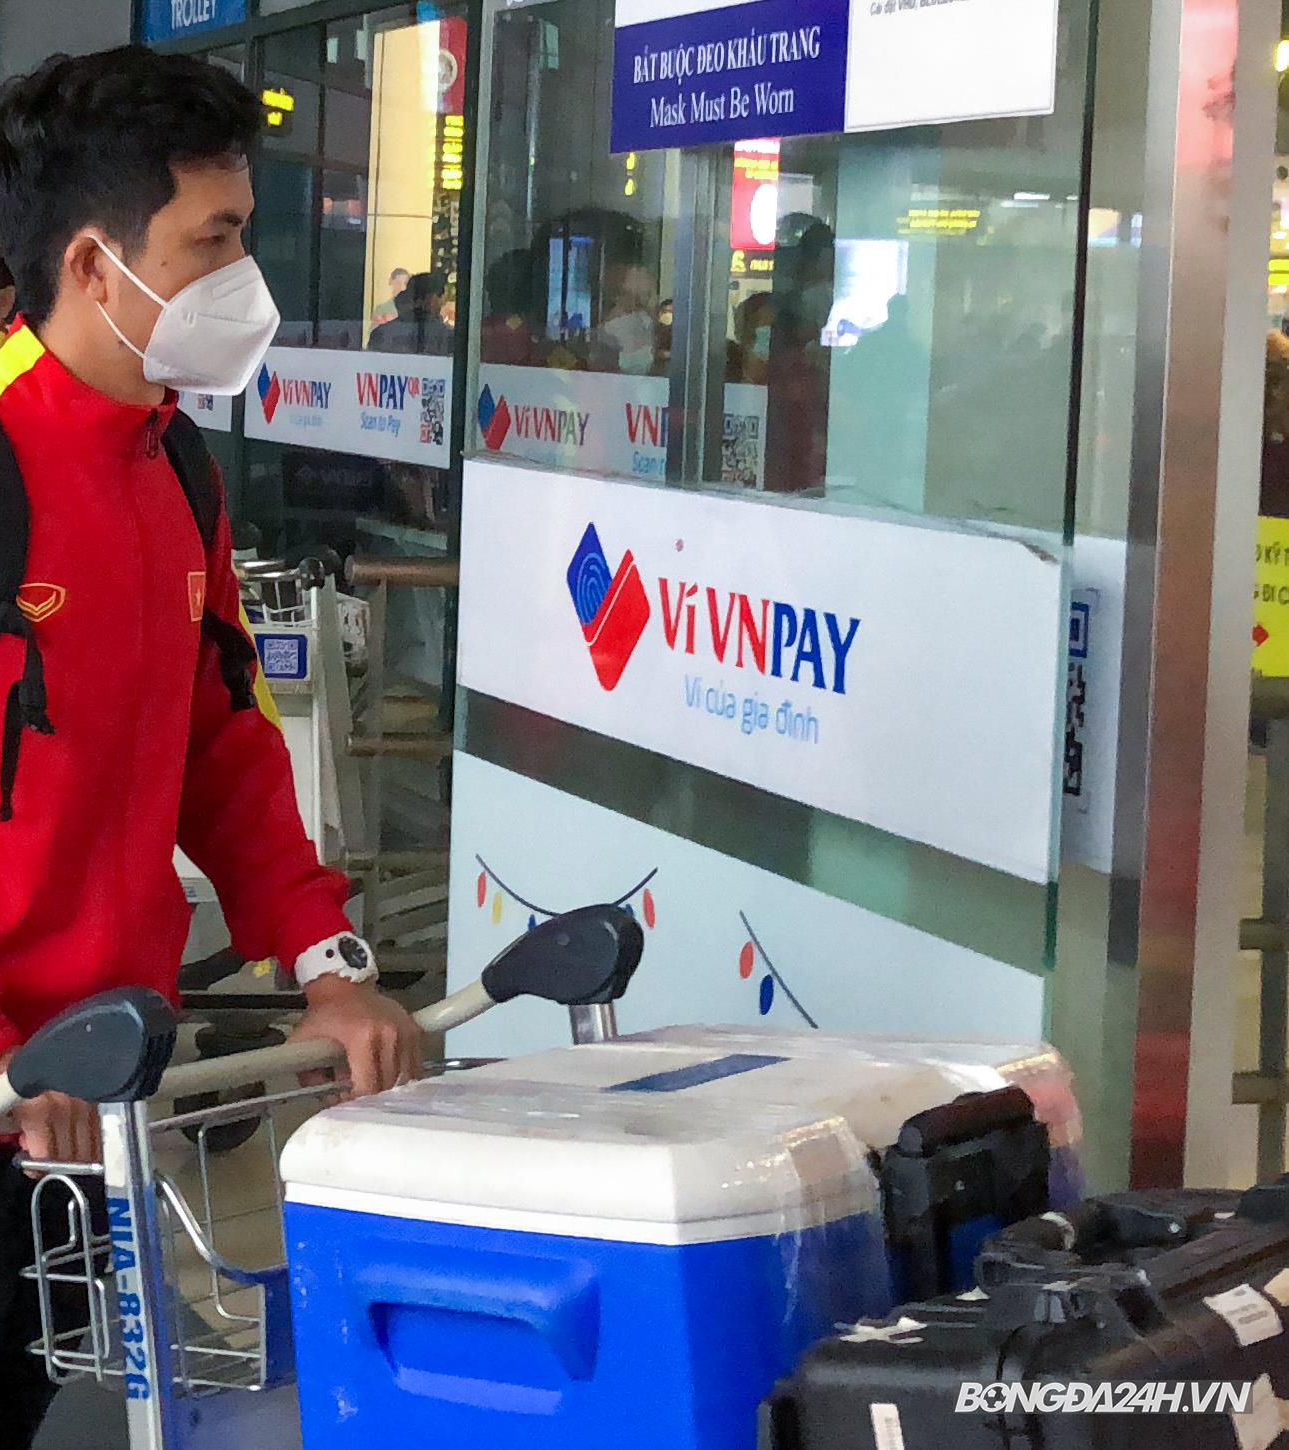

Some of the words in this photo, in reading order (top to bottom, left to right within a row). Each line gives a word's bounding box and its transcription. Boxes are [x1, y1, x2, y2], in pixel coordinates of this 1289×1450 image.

[770, 26, 821, 63] TRANG
[650, 93, 686, 128] Mask
[690, 92, 725, 123] Must
[730, 86, 750, 118] Be
[754, 81, 794, 115] Worn
[294, 379, 332, 410] VNPAY
[533, 406, 590, 447] VNPAY
[658, 576, 698, 655] Ví
[705, 586, 861, 695] VNPAY
[741, 691, 769, 735] gia
